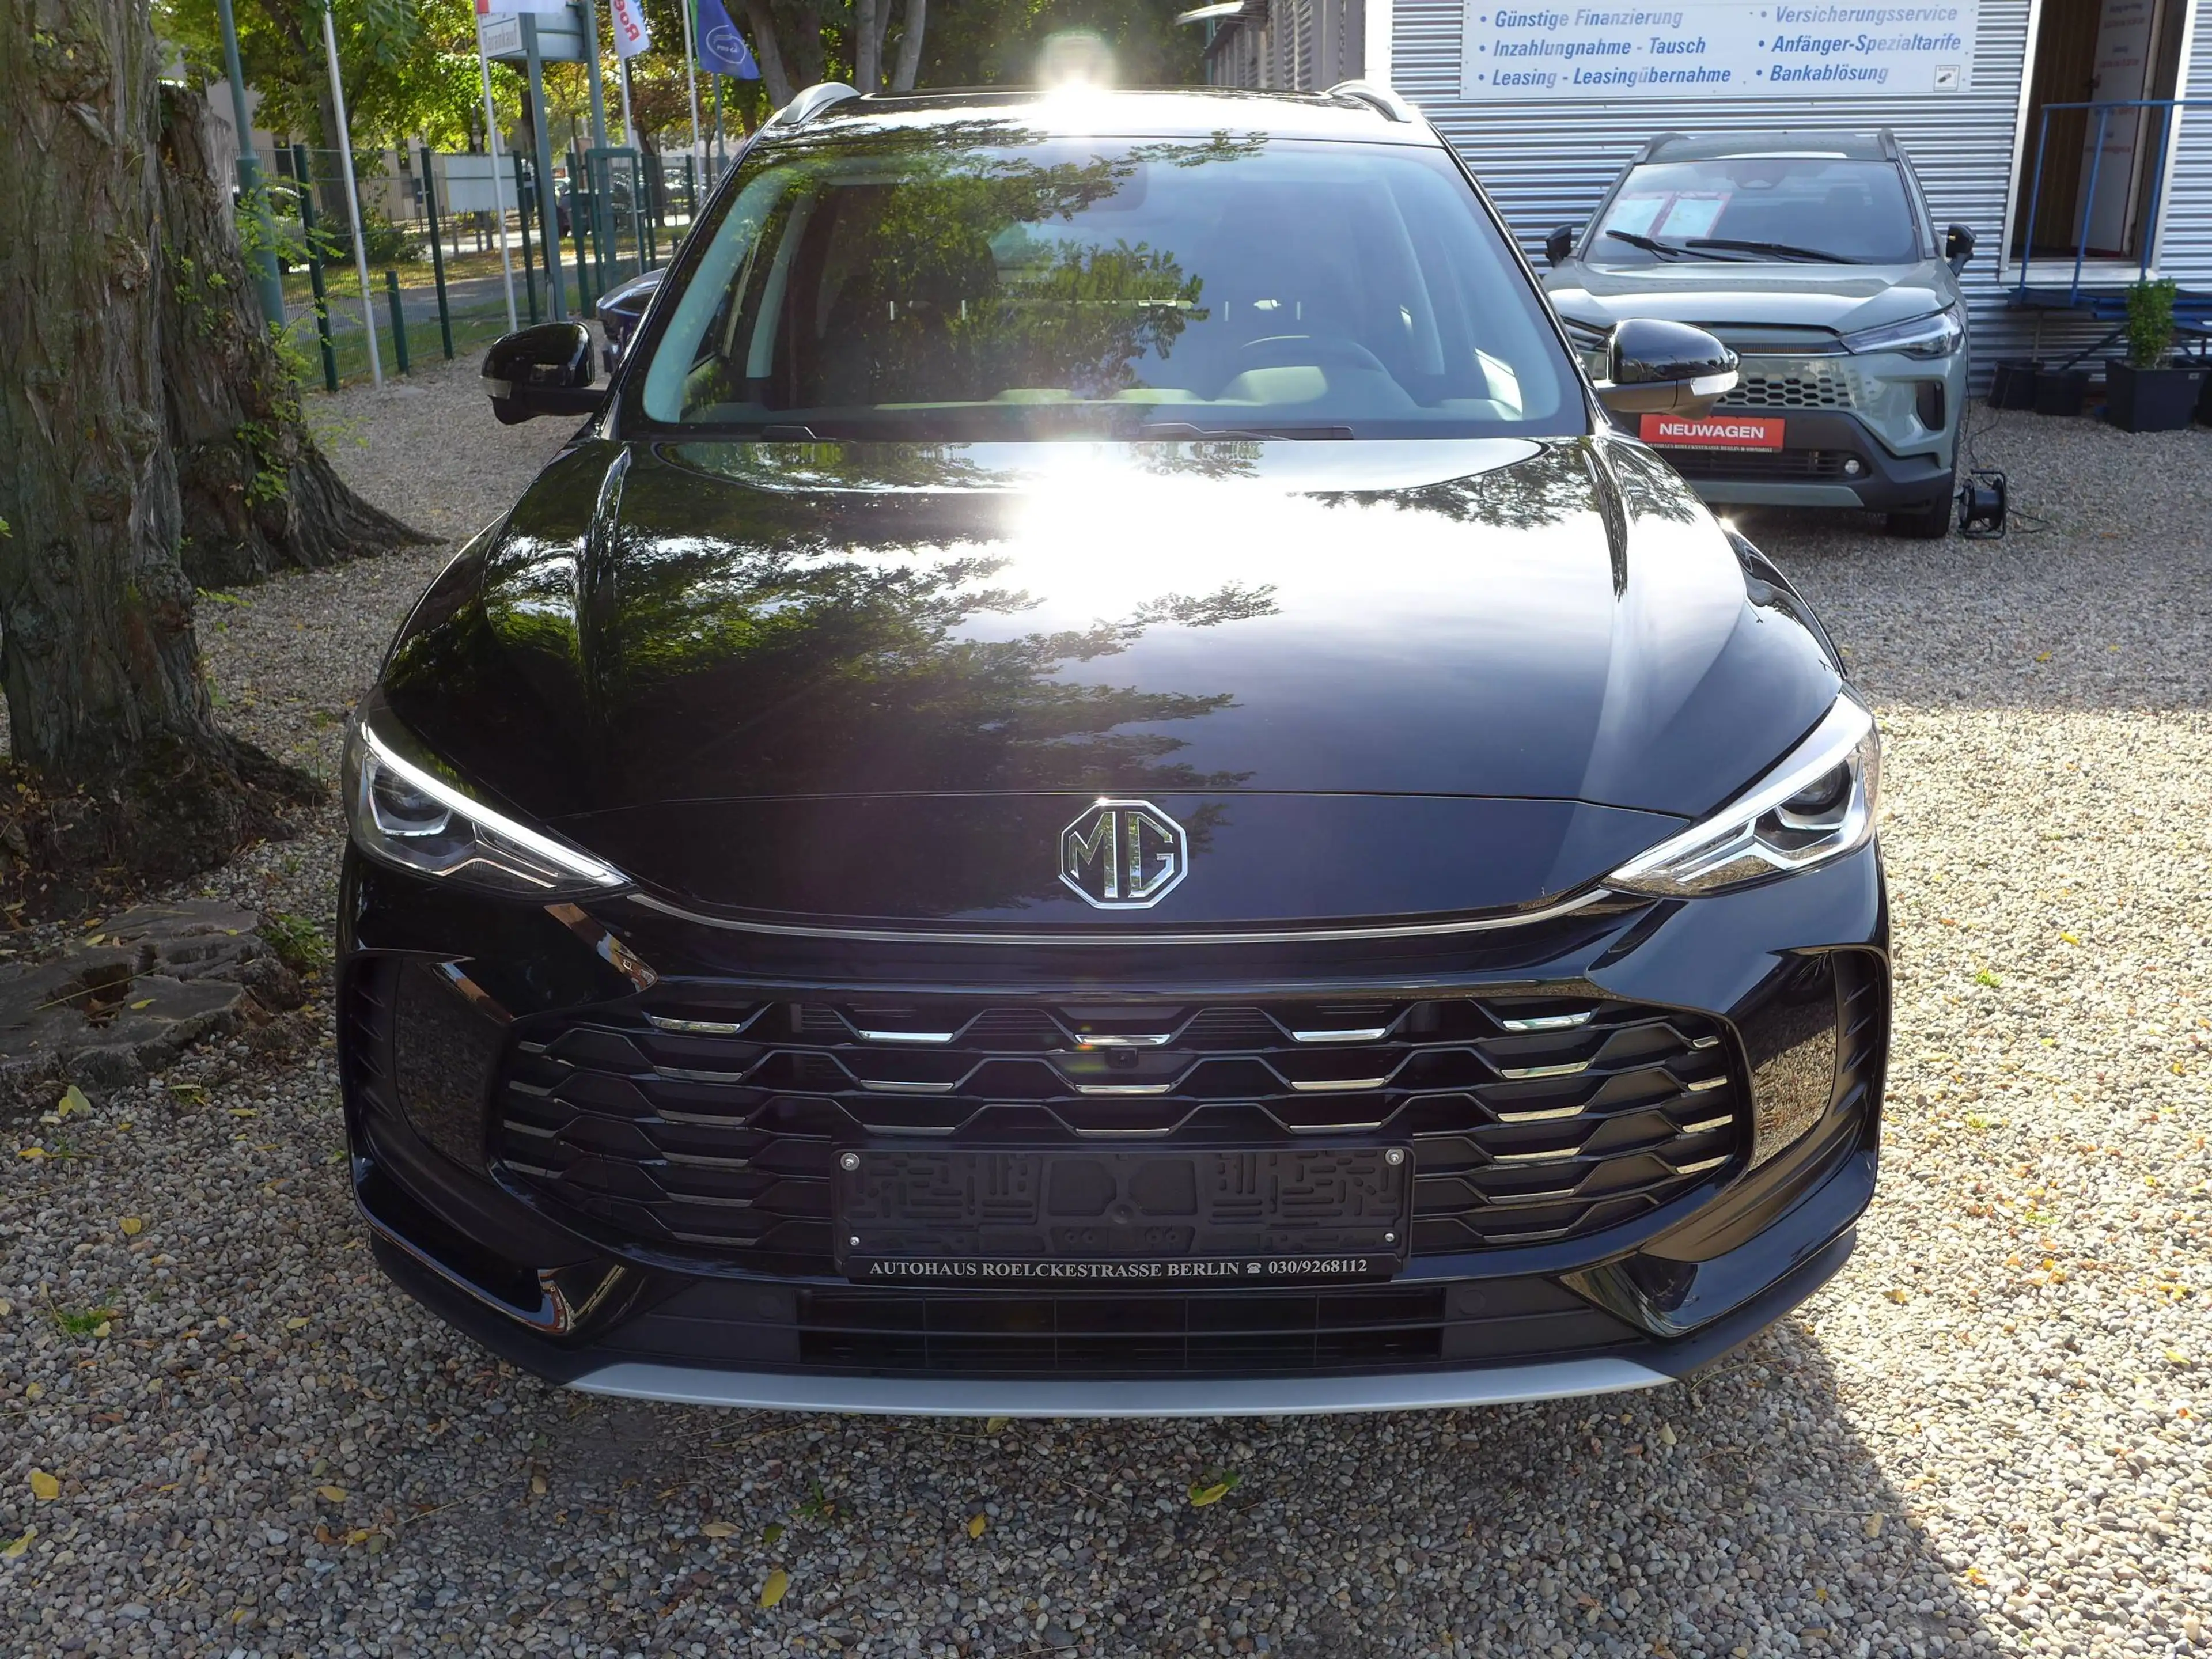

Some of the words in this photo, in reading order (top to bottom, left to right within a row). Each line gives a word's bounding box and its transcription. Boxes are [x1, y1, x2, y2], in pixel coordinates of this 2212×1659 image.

[1495, 10, 1569, 31] Günstige
[1574, 9, 1683, 29] Finanzierung
[1775, 4, 1957, 26] Versicherungsservice
[1493, 38, 1631, 59] Inzahlungnahme
[1649, 36, 1706, 54] Tausch
[1771, 33, 1961, 55] Anfänger-Spezialtarife
[1492, 68, 1557, 88] Leasing
[1573, 66, 1731, 87] Leasingübernahme
[1770, 64, 1889, 84] Bankablösung
[1659, 423, 1765, 439] NEUWAGEN
[1067, 810, 1175, 899] MG
[869, 1262, 977, 1276] AUTOHAUS
[982, 1263, 1162, 1277] ROELCKESTRASSE
[1167, 1262, 1239, 1277] BERLIN
[1268, 1259, 1368, 1275] 030/9268112
